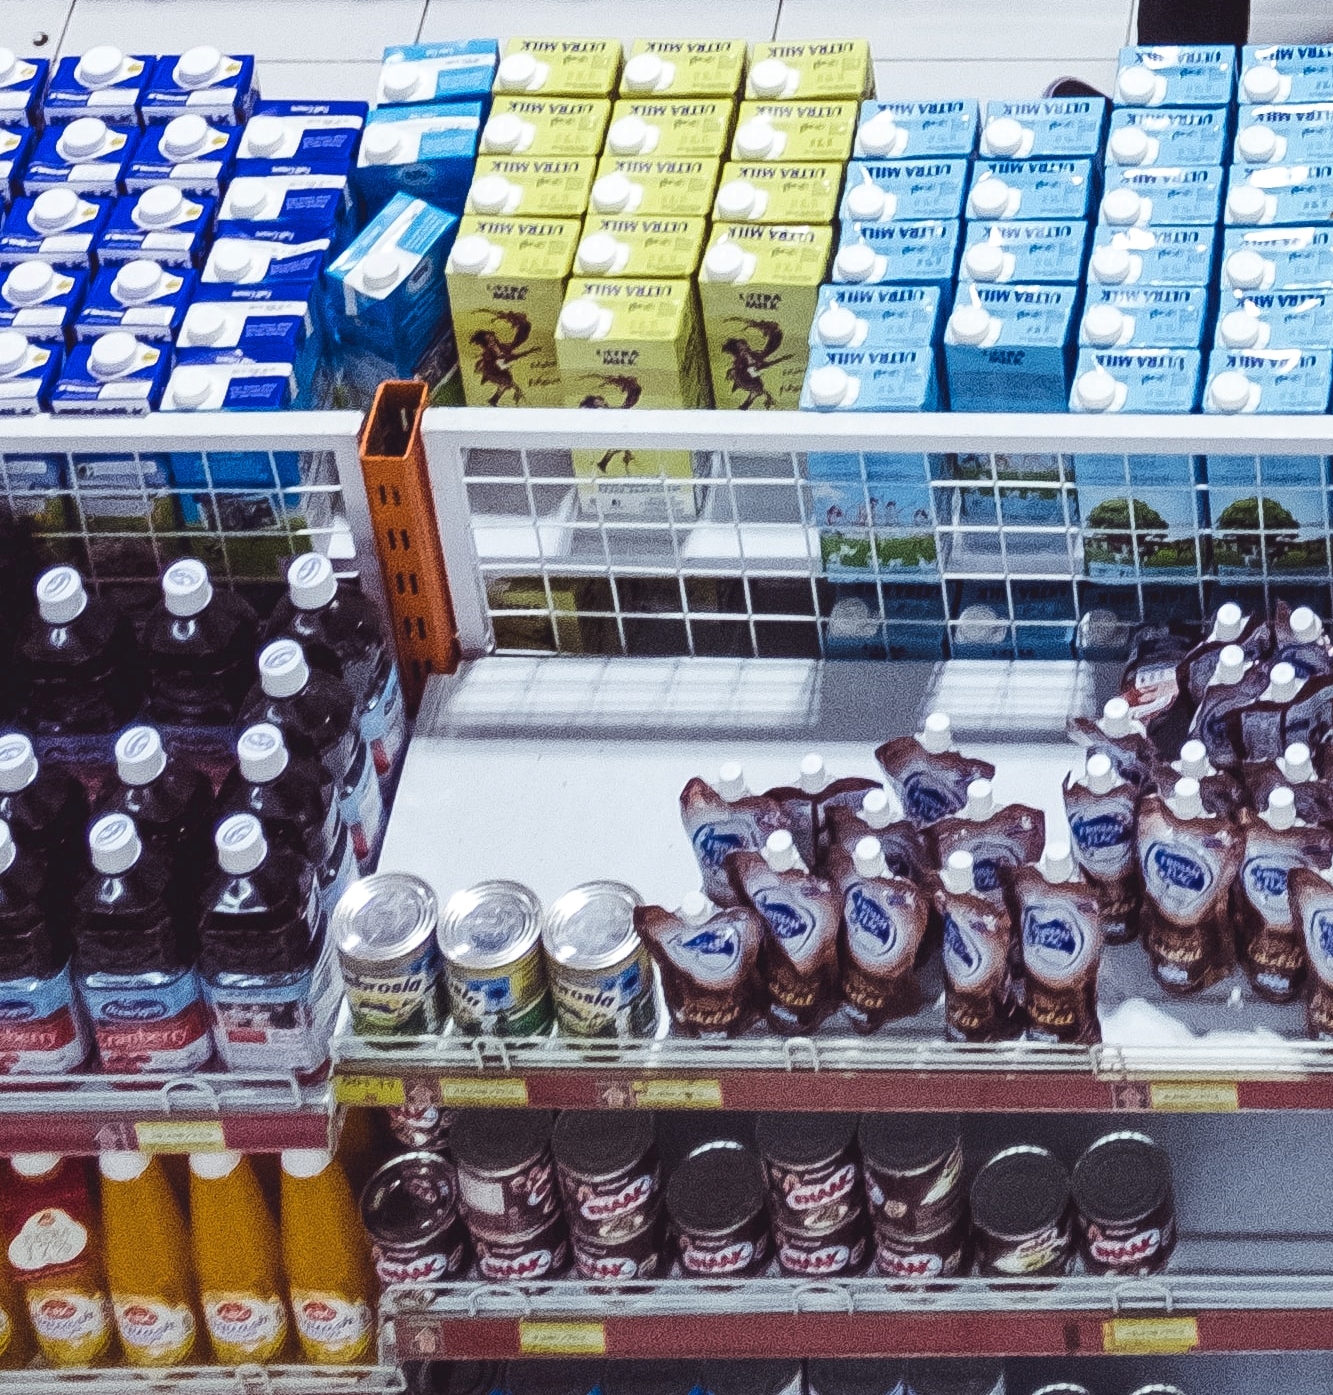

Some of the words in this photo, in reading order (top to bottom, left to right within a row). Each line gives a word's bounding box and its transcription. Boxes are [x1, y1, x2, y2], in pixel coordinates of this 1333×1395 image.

[522, 40, 561, 52] MILK
[561, 42, 607, 53] ULTRA
[646, 41, 685, 54] MILK
[687, 42, 732, 54] ULTRA
[768, 46, 804, 58] MILK
[807, 43, 854, 56] ULTRA
[508, 102, 548, 113] MILK
[550, 104, 594, 115] ULTRA
[630, 103, 670, 116] MILK
[672, 104, 716, 116] ULTRA
